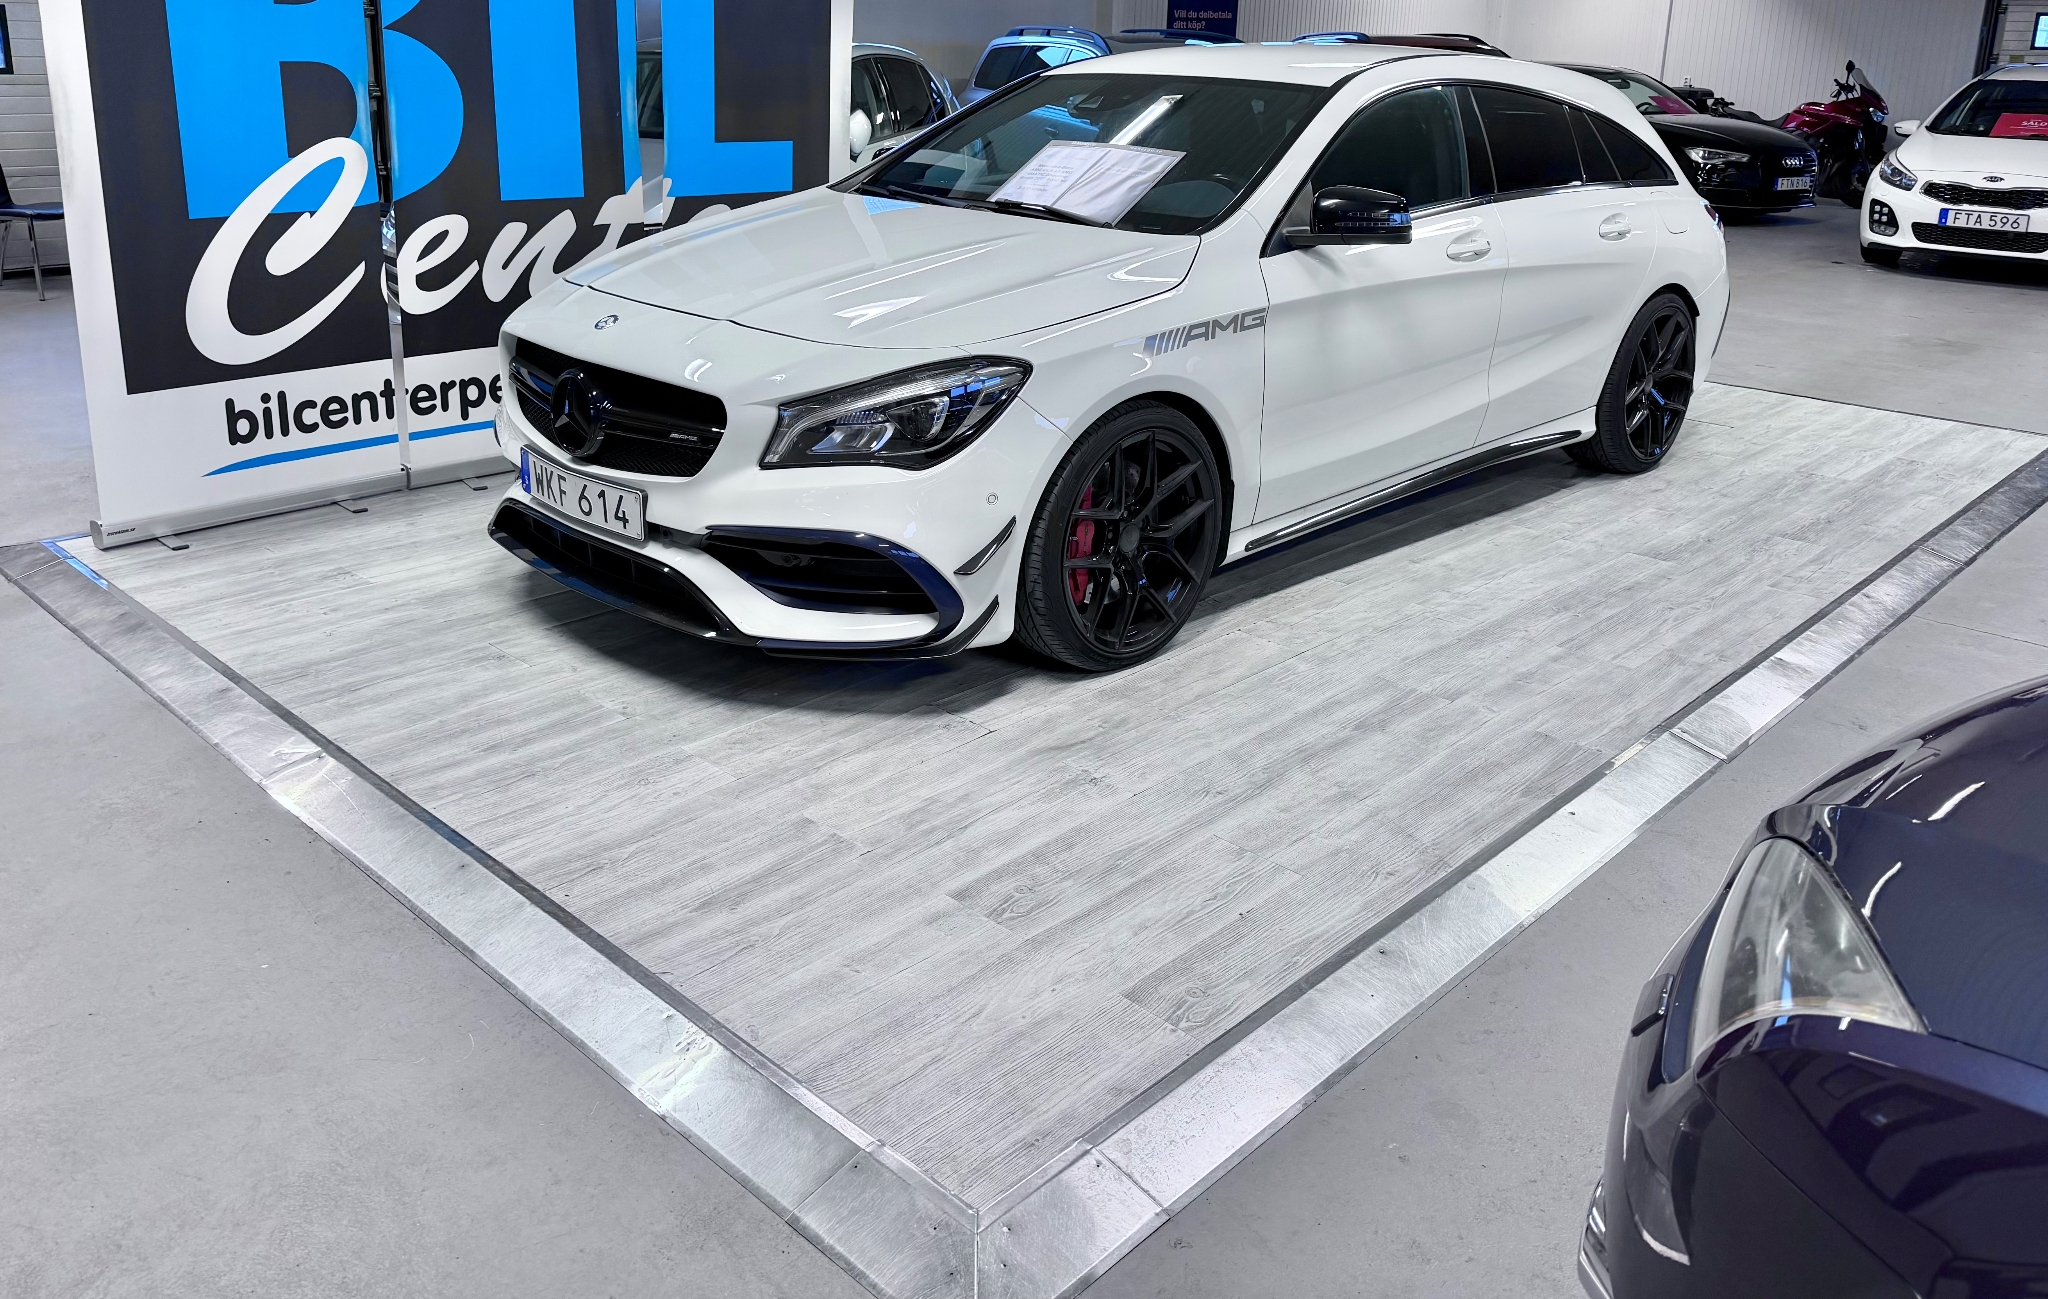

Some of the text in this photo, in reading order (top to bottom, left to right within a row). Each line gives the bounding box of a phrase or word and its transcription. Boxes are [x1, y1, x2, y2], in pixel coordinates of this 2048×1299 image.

[1174, 10, 1187, 18] Vill
[1188, 10, 1198, 18] du
[1173, 20, 1206, 31] ditt köp?
[1953, 212, 2021, 230] FTA 596
[532, 460, 630, 530] WKF 614
